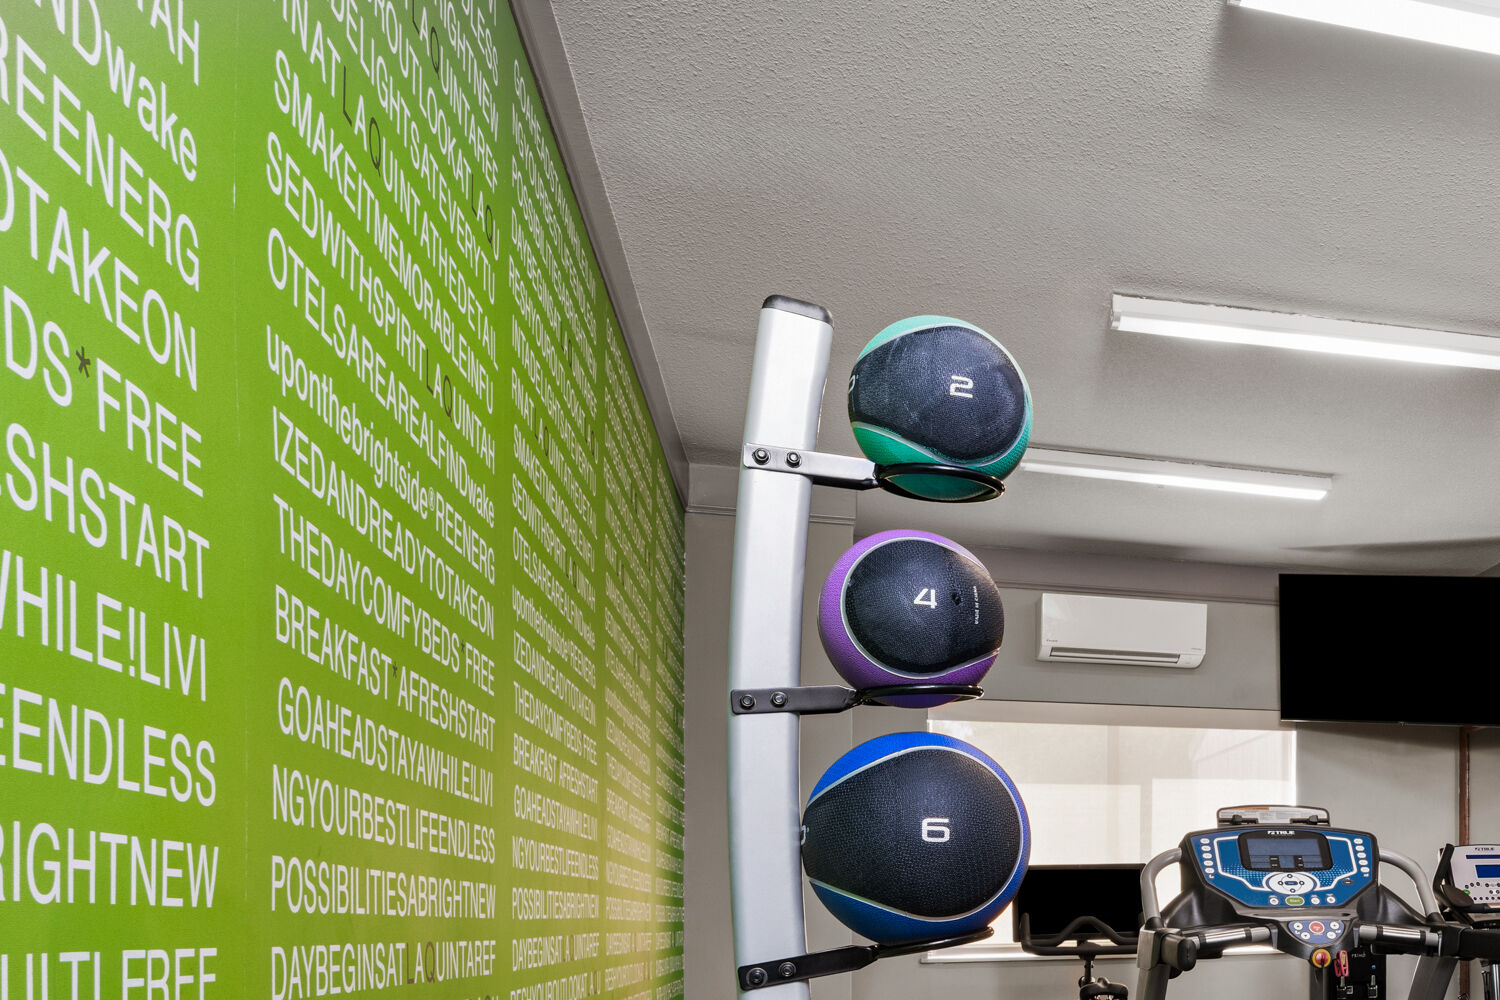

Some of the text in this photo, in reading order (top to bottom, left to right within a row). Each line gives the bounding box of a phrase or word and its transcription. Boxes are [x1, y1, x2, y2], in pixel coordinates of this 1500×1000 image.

[34, 0, 197, 182] Dwake
[137, 0, 199, 86] AH
[0, 16, 199, 292] EENERG
[330, 0, 495, 305] ELIGHTSATEVERYTU
[274, 49, 493, 414] SMAKEITMEMORABLEINFU
[266, 131, 495, 475] SEDWITHSPIRITLAQUINTAH
[267, 227, 494, 528] OTELSAREAREALFINDwake
[949, 374, 974, 398] 2
[272, 406, 494, 640] IZEDANDREADYTOTAKEON
[914, 587, 937, 609] 4
[0, 683, 216, 807] ENDLESS
[278, 677, 493, 807] GOAHEADSTAYAWHILE!LIVI
[0, 821, 219, 908] IGHTNEW
[273, 764, 495, 864] NGYOURBESTLIFEENDLESS
[921, 817, 950, 843] 6
[271, 855, 496, 919] POSSIBILITIESABRIGHTNEW
